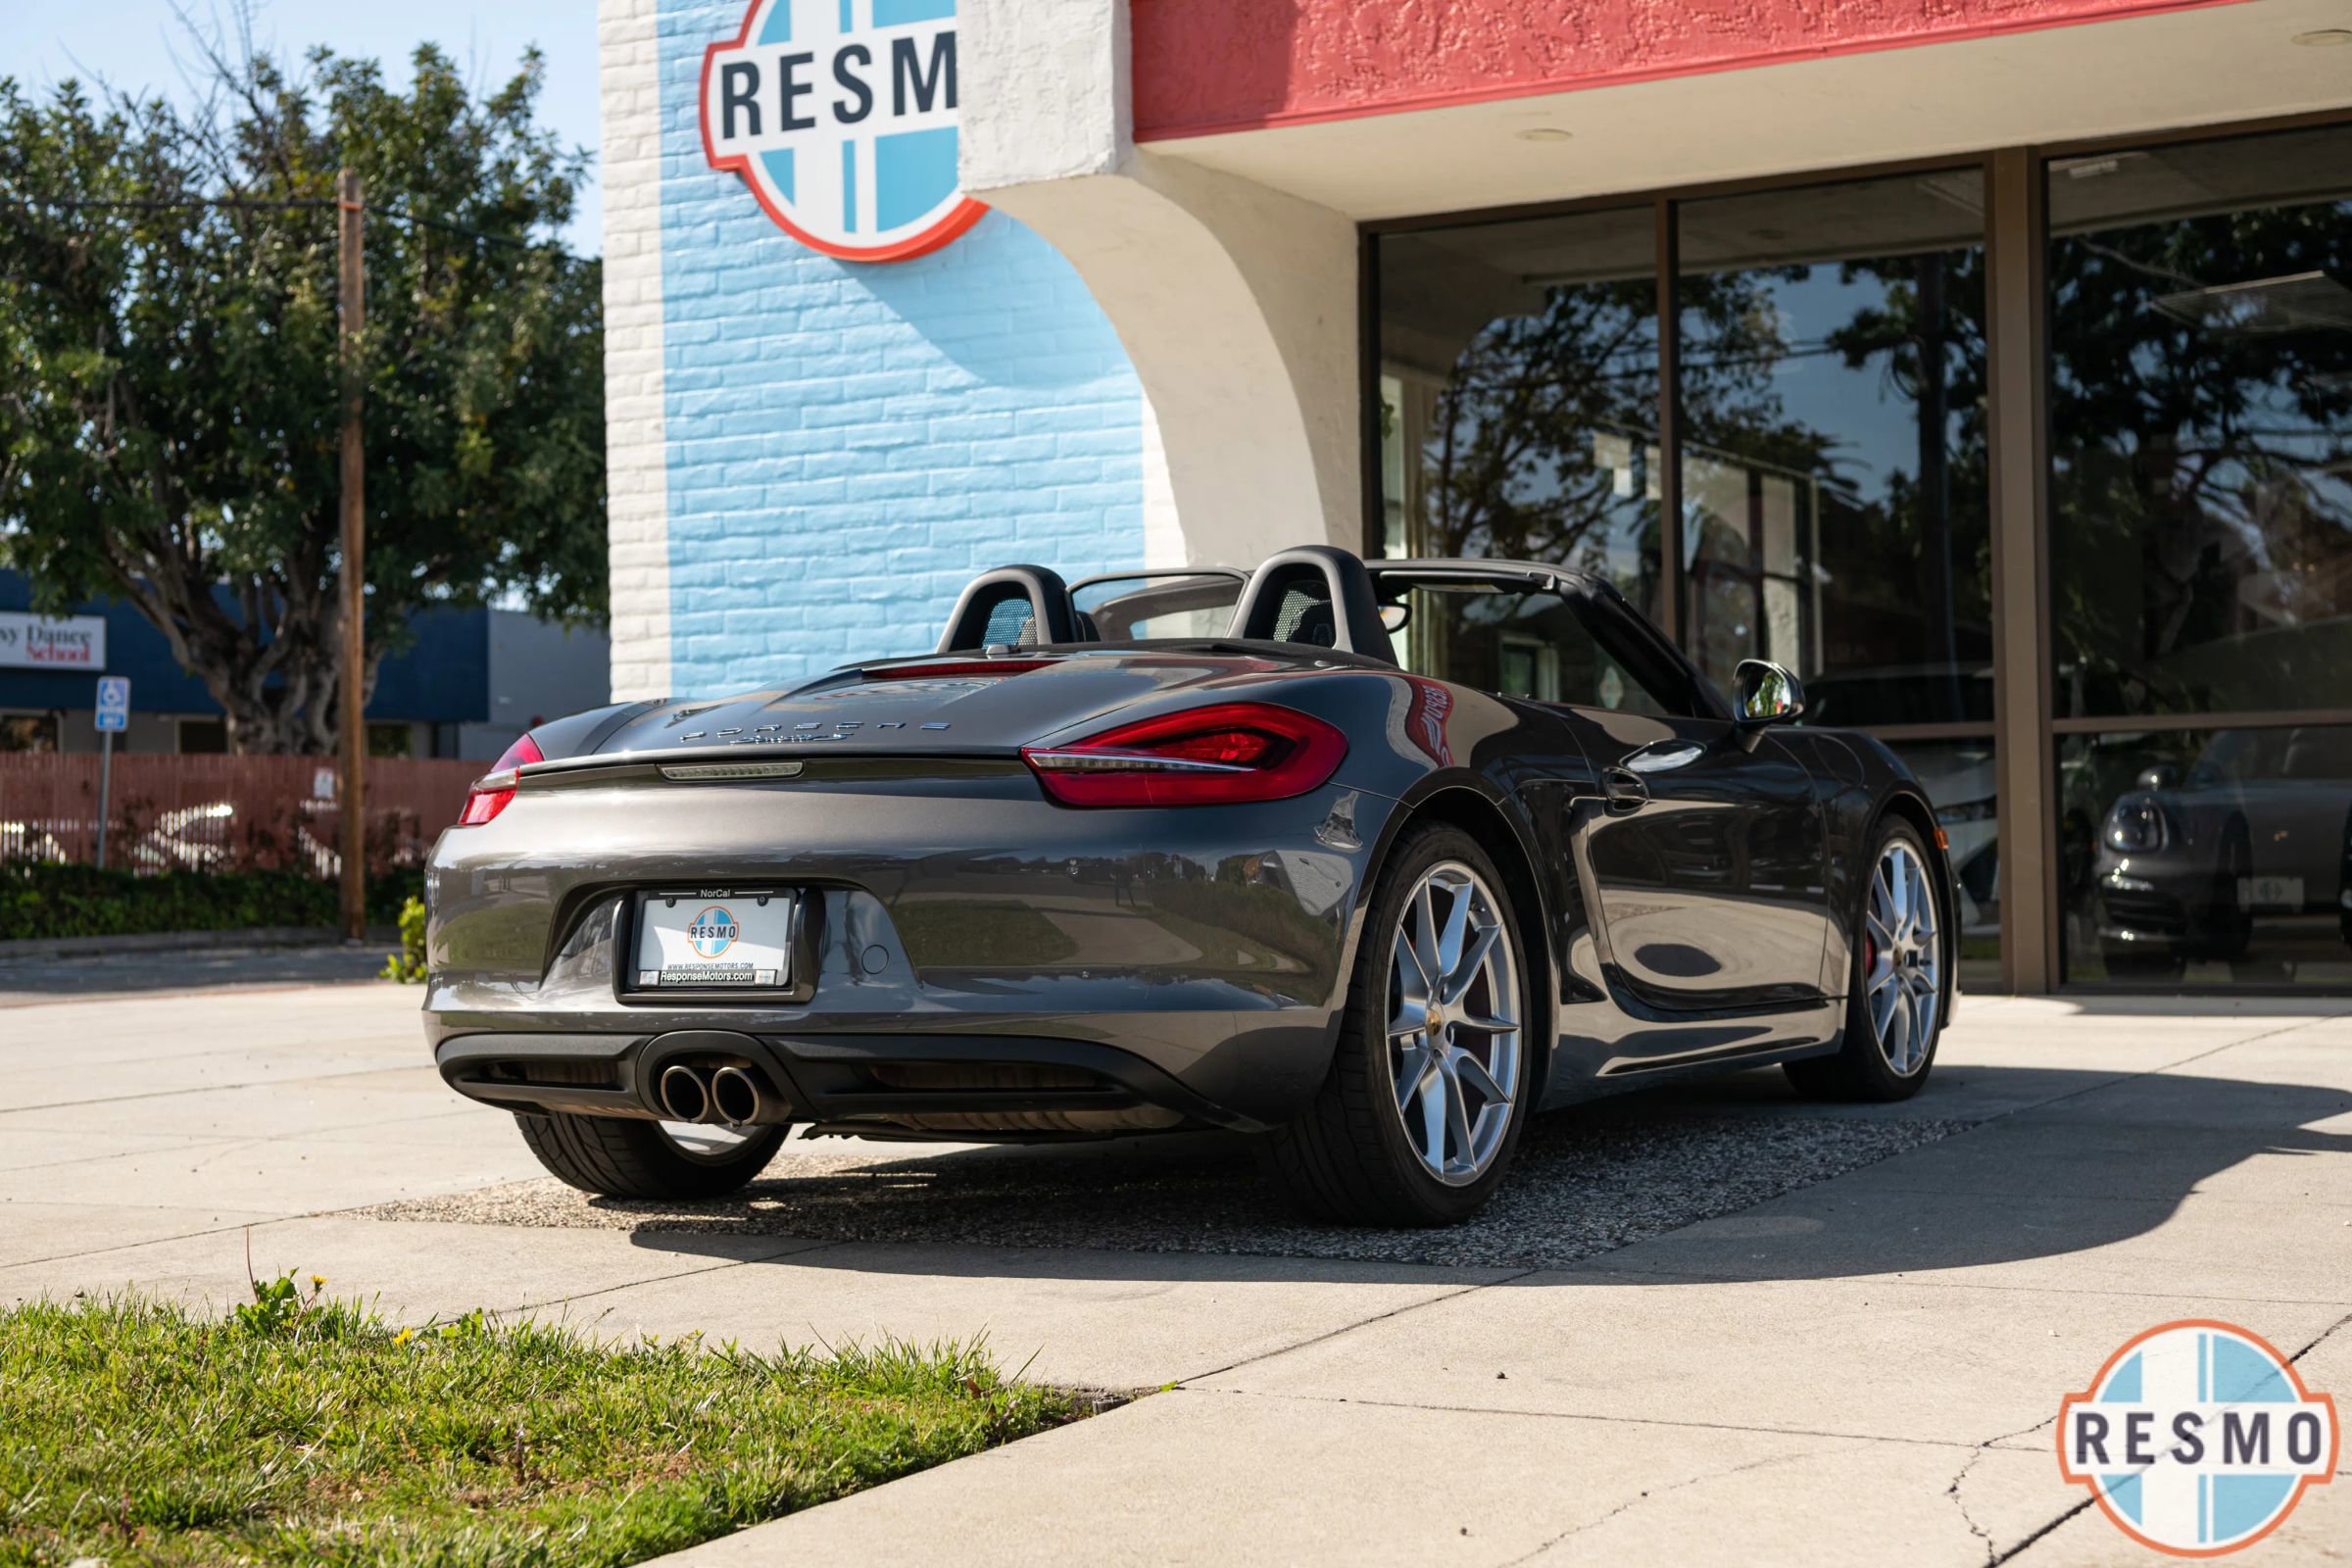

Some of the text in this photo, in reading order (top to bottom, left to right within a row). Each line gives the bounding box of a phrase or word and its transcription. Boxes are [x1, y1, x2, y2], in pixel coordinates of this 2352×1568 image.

[26, 624, 92, 646] Dance
[25, 643, 90, 662] School
[700, 889, 731, 898] NorCal
[690, 925, 736, 939] RESMO
[661, 971, 753, 983] ResponseMotors.com
